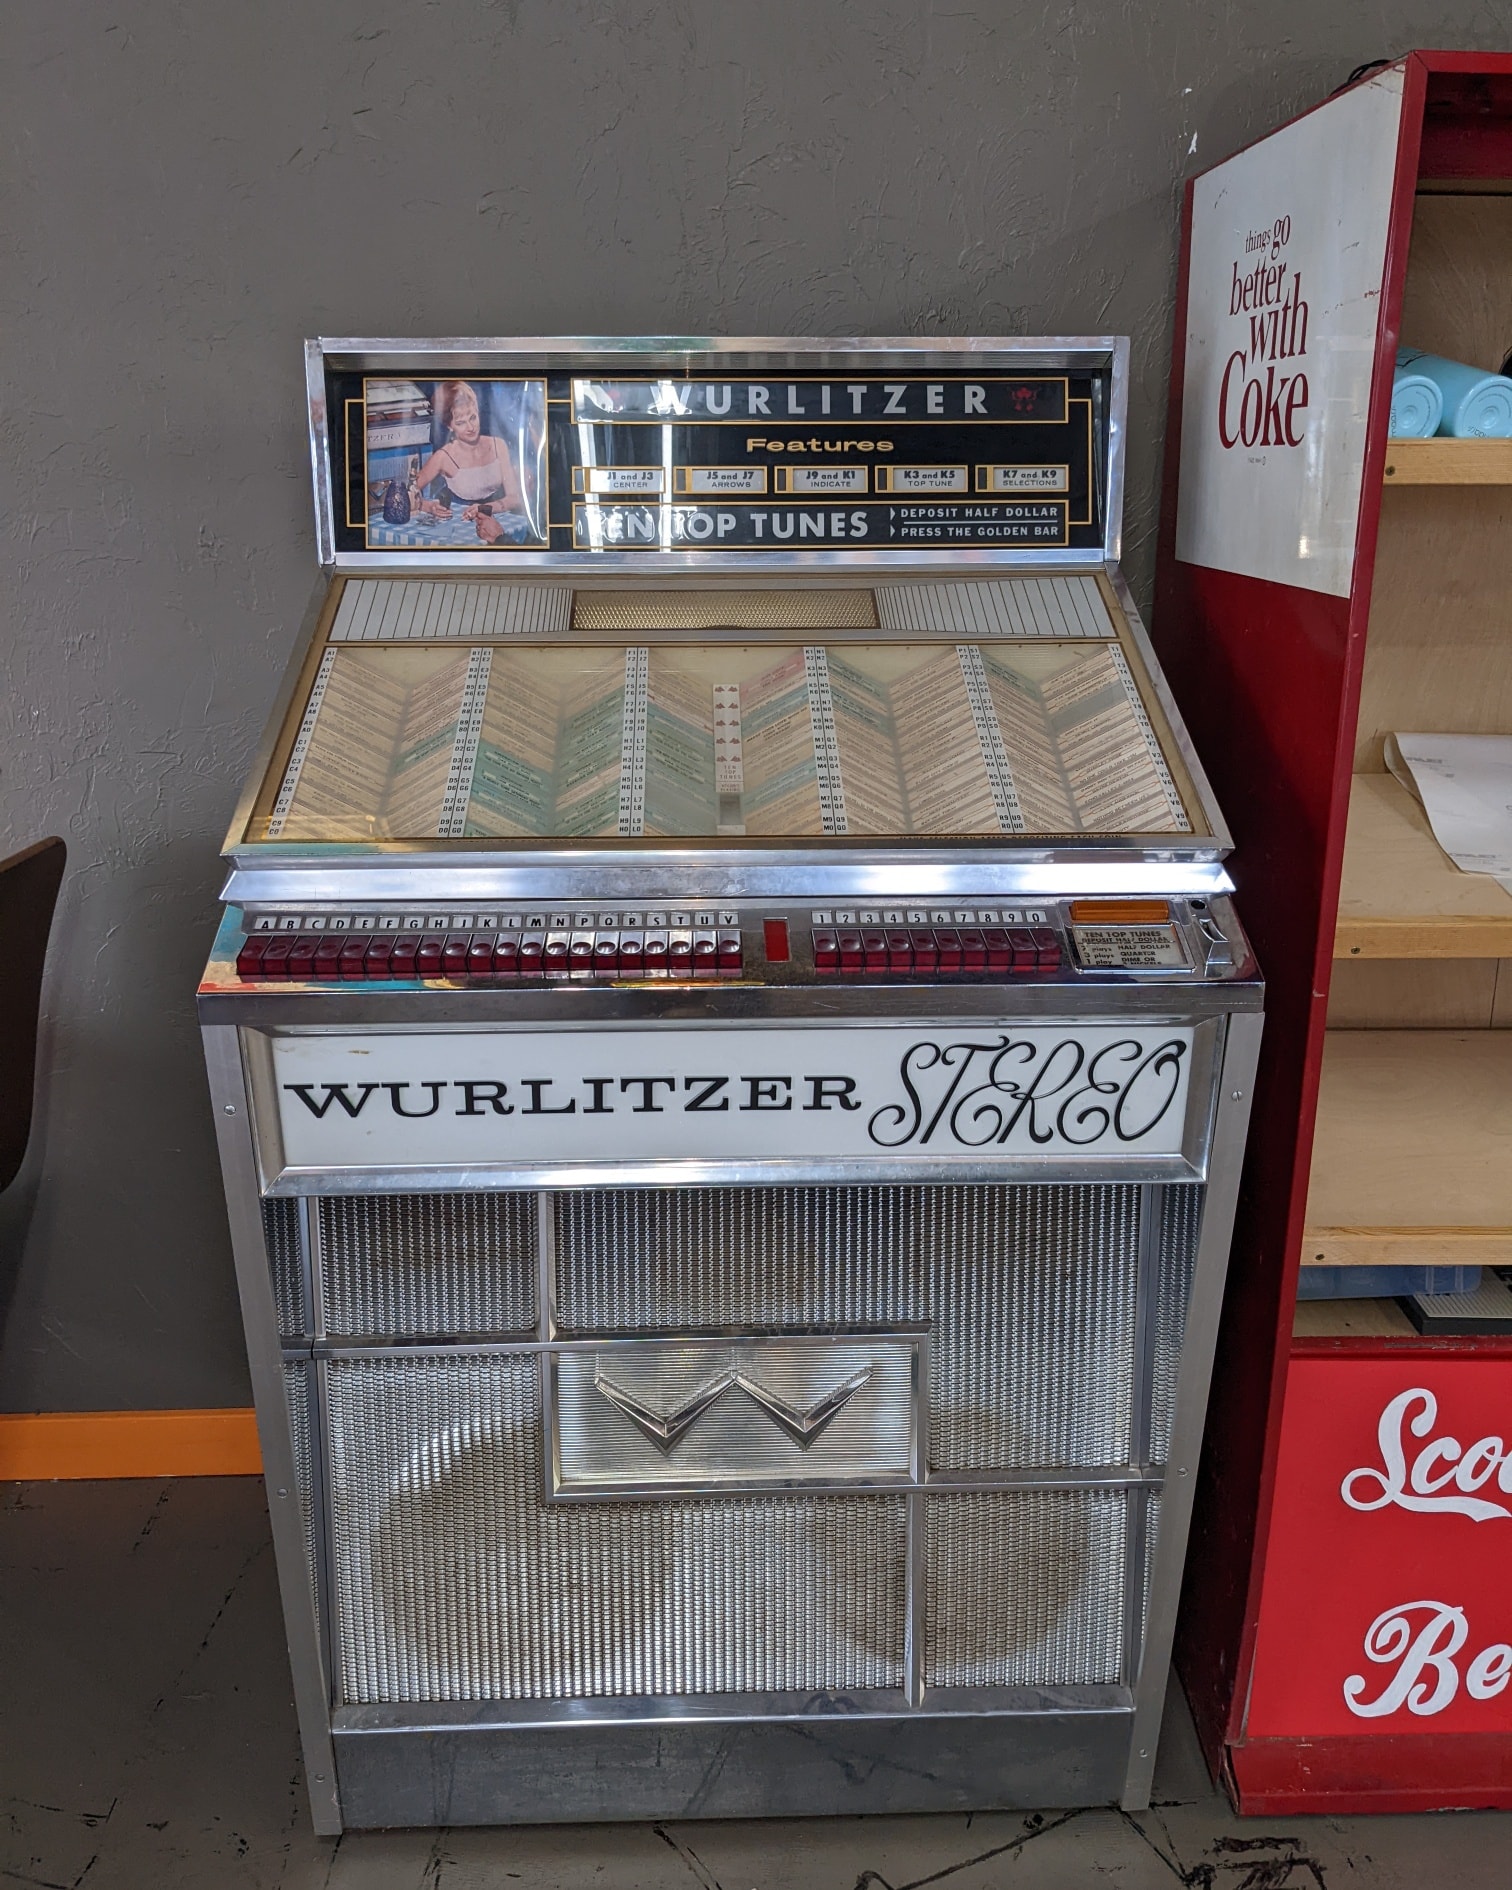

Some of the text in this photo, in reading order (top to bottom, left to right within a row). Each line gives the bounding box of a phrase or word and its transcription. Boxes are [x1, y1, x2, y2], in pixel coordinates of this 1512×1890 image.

[1245, 215, 1291, 260] things go
[1229, 256, 1287, 315] better
[1249, 272, 1308, 364] with
[650, 385, 988, 415] WURLITZER
[1218, 350, 1309, 449] Coke
[746, 438, 895, 453] Features
[607, 471, 617, 480] J1
[641, 471, 654, 480] J3
[707, 471, 755, 480] J5 and J7
[806, 470, 856, 480] J9 and K1
[904, 470, 955, 480] K3 and K5
[1003, 470, 1057, 479] K7 and K9
[901, 506, 1058, 518] DEPOSIT HALF DOLLAR
[750, 512, 868, 538] TUNES
[901, 525, 1059, 537] PRESS THE GOLDEN BAR
[261, 920, 269, 929] A
[287, 920, 294, 929] B
[312, 920, 320, 929] C
[336, 920, 344, 929] D
[362, 919, 369, 928] E
[386, 919, 393, 928] F
[410, 919, 418, 928] G
[435, 919, 443, 928] H
[484, 919, 492, 927] K
[509, 918, 515, 927] L
[530, 918, 542, 927] M
[556, 918, 564, 926] N
[581, 918, 588, 926] P
[605, 917, 613, 926] Q
[628, 917, 636, 925] R
[654, 917, 660, 925] S
[677, 917, 684, 925] T
[725, 916, 733, 924] V
[819, 914, 824, 923] 1
[842, 914, 849, 923] 2
[866, 914, 873, 923] 3
[890, 914, 897, 923] 4
[914, 913, 921, 923] 5
[937, 913, 944, 923] 6
[961, 913, 967, 923] 7
[985, 913, 991, 922] 8
[1008, 913, 1015, 922] 9
[283, 1035, 1187, 1147] WURLITZER STEREO
